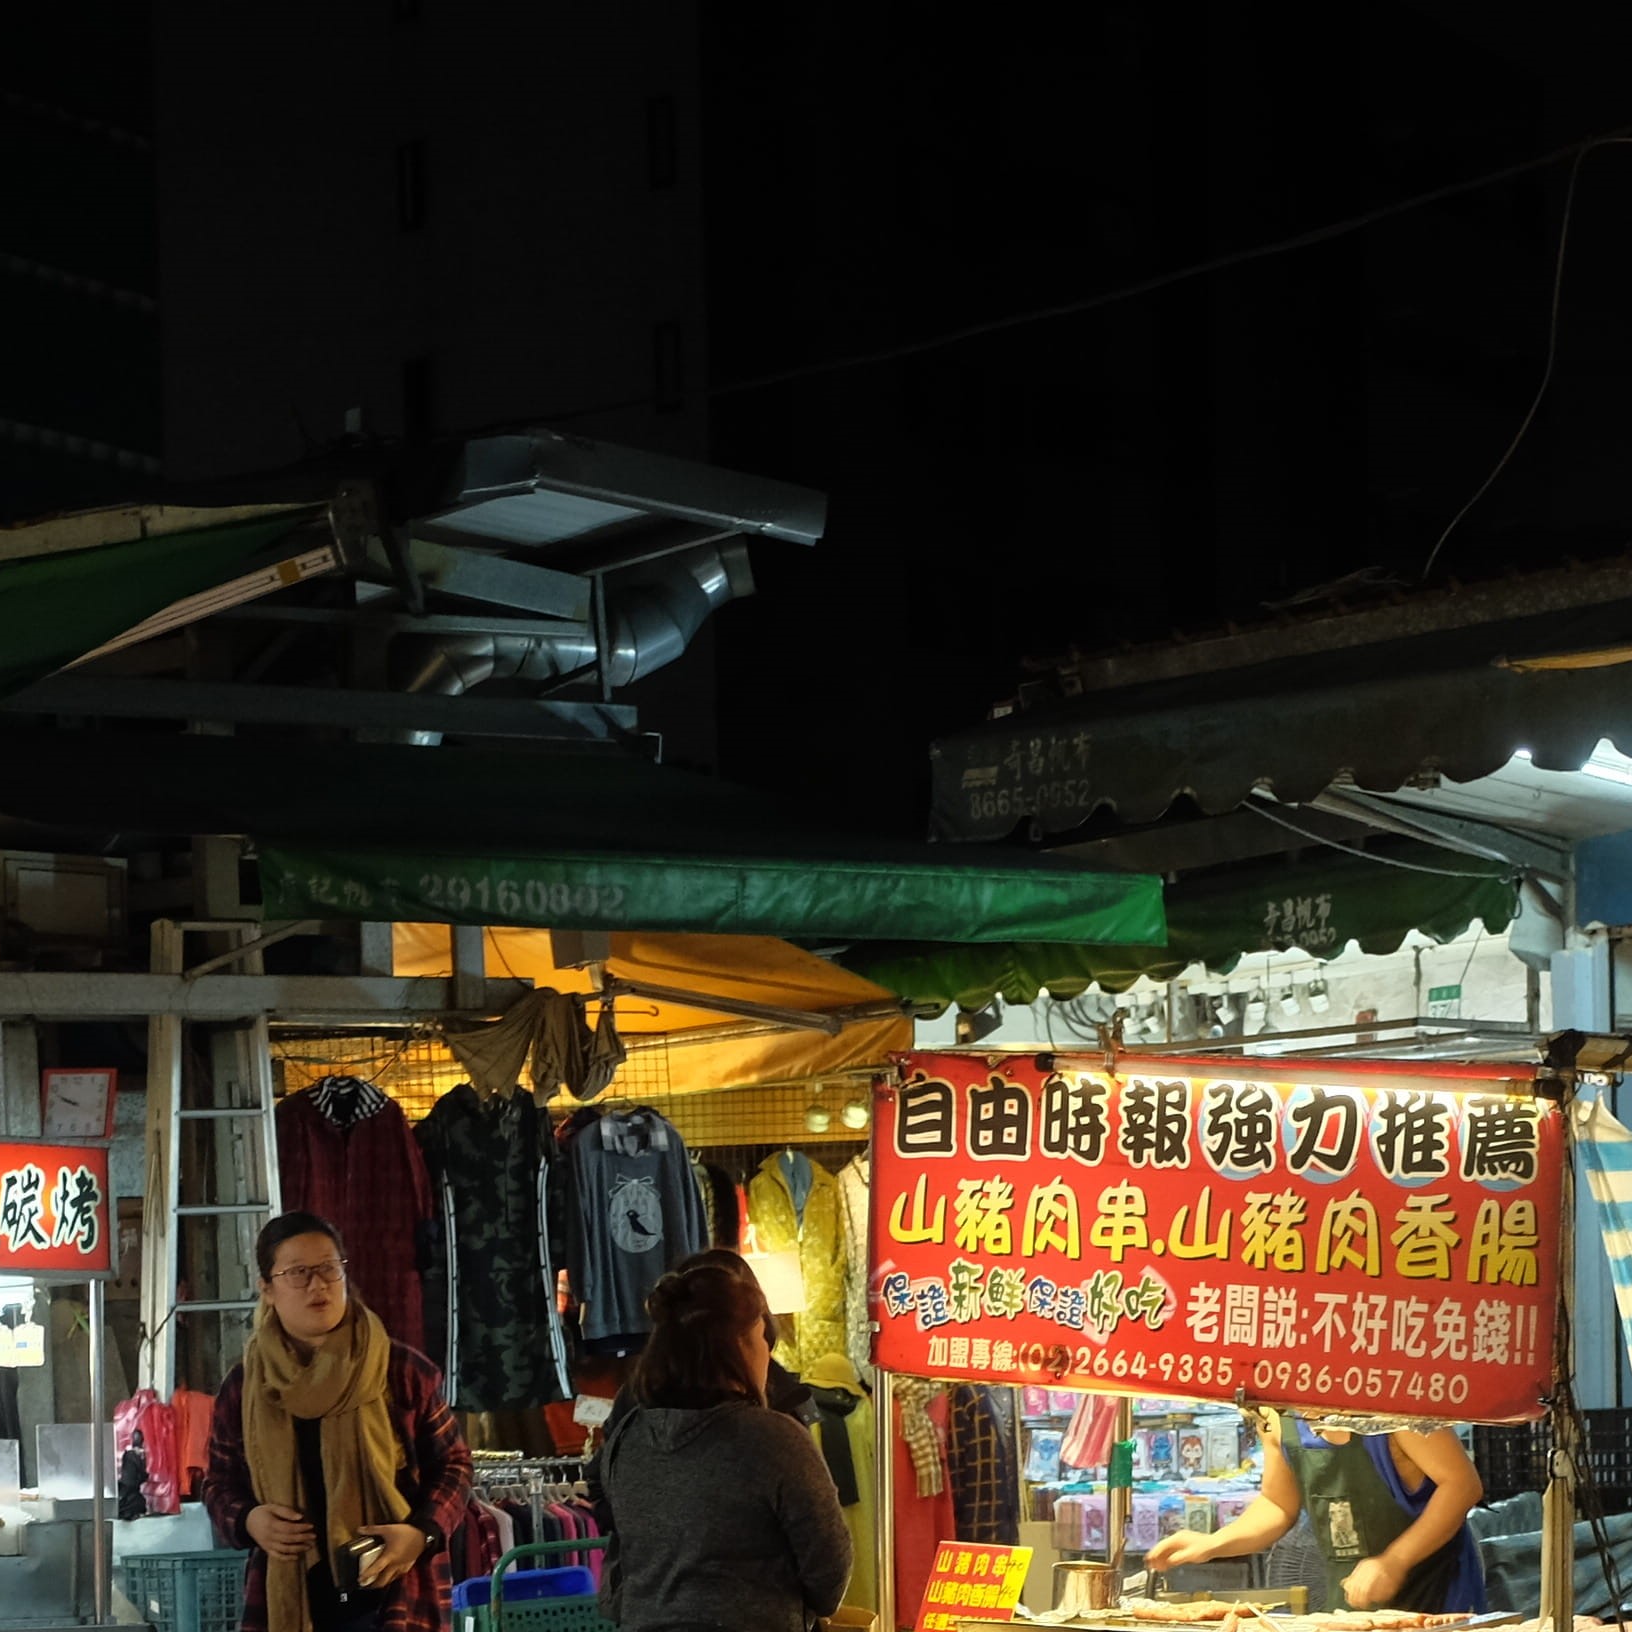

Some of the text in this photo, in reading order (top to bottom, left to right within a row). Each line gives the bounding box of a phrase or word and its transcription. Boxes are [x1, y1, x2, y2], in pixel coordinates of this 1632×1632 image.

[893, 1074, 1540, 1183] 自由時報強力推薦
[888, 1173, 1539, 1287] 山豬肉串.山豬肉香腸
[882, 1260, 1169, 1334] 保證新鮮保證好吃
[936, 1549, 1009, 1577] 山豬肉串
